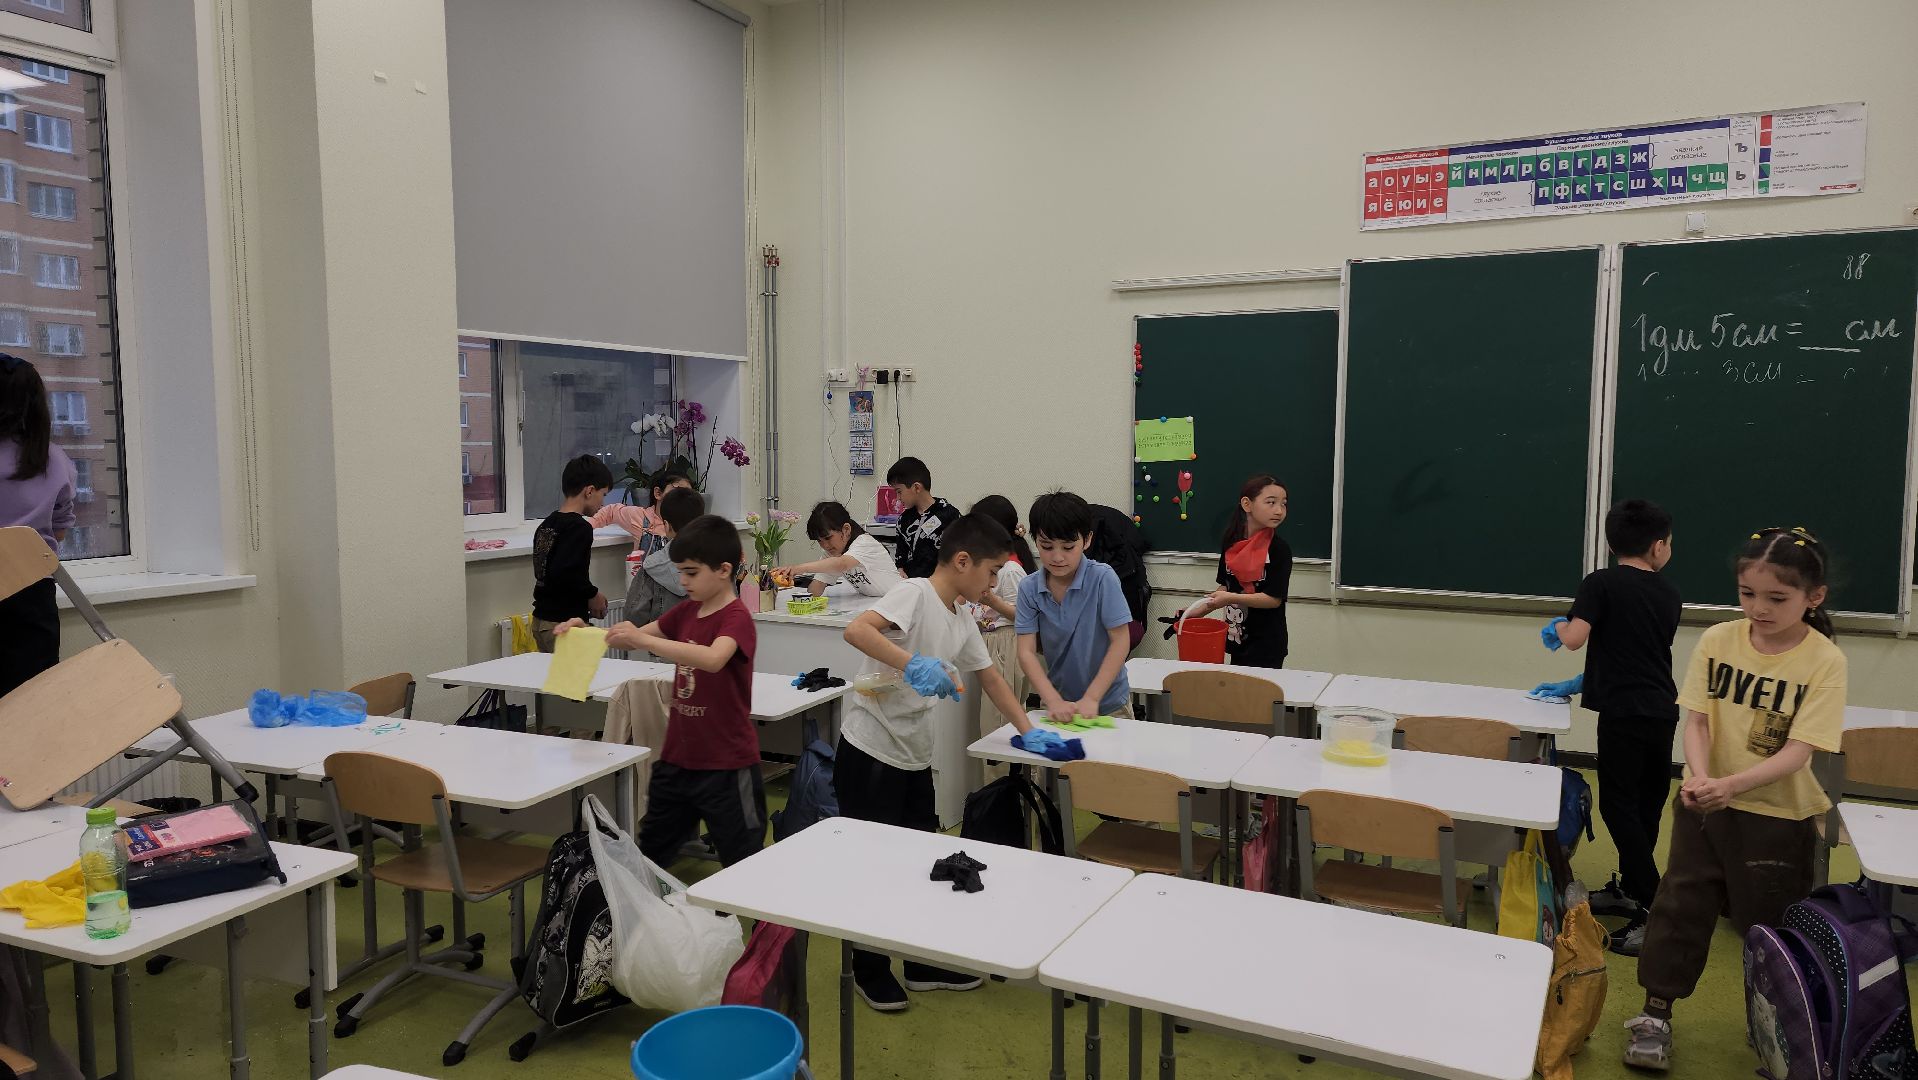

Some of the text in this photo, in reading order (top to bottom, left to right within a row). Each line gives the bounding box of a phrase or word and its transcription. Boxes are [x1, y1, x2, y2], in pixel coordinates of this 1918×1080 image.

[1368, 170, 1444, 188] а о у ы э
[1451, 151, 1647, 181] й н м л р б в г д з ж
[1539, 170, 1726, 200] п ф к т с ш х ц ч щ
[1368, 196, 1443, 213] я ё ю и е
[1707, 657, 1809, 718] LOVELY
